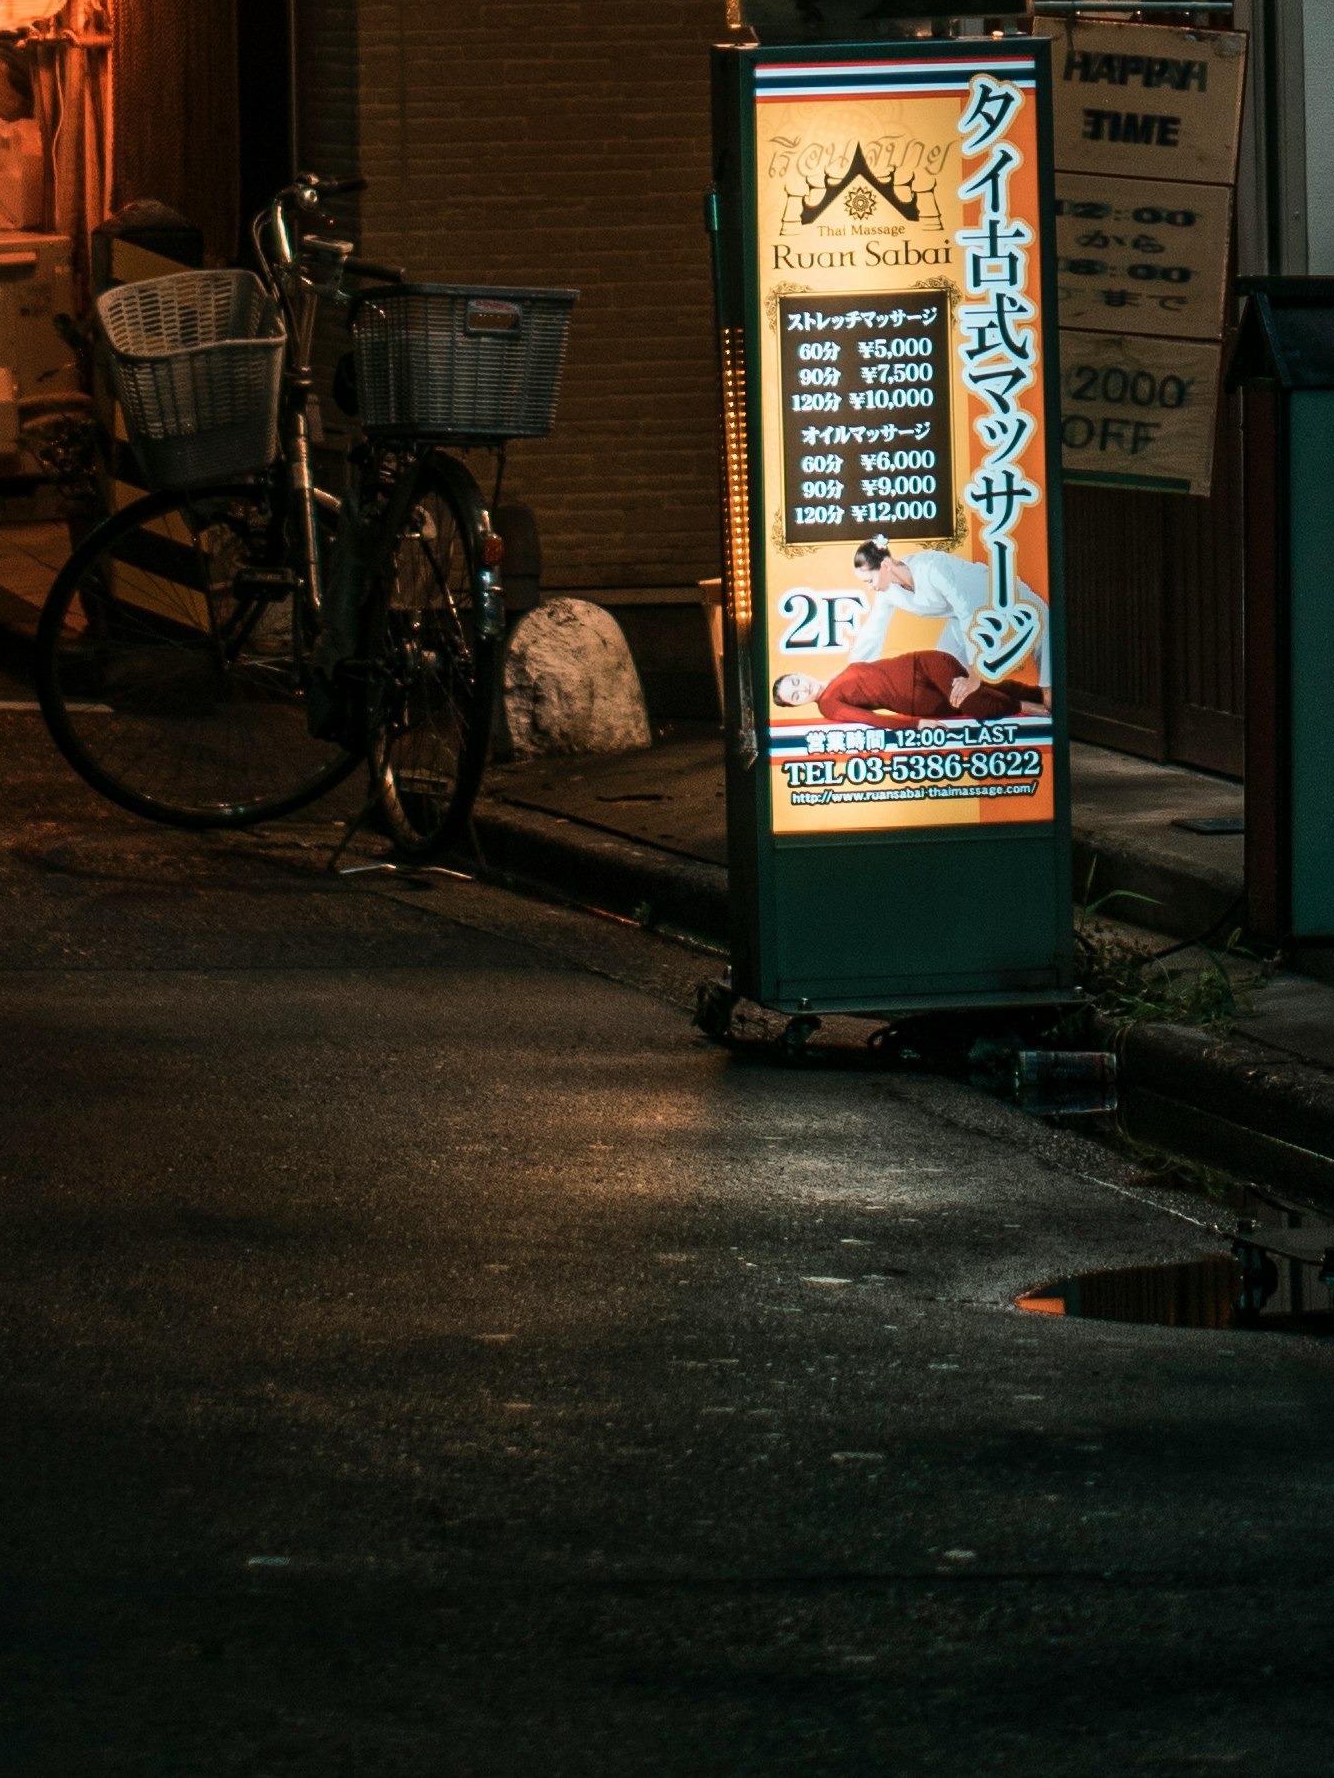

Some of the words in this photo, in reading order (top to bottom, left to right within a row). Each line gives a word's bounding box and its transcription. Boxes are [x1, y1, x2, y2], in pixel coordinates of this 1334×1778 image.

[1083, 108, 1182, 147] TIME
[817, 225, 846, 237] Thai
[851, 224, 906, 238] Massage
[1076, 230, 1166, 254] から
[772, 243, 857, 270] Ruan
[865, 239, 954, 267] Sabai
[787, 306, 938, 332] ストレッチマッサージ
[799, 341, 841, 361] 60分
[858, 337, 933, 360] ¥5,000
[799, 366, 842, 387] 90分
[860, 362, 934, 385] ¥7,500
[962, 81, 1037, 675] タイ古式マッサージ
[791, 391, 843, 412] 120分
[848, 387, 934, 410] ¥10,000
[801, 421, 931, 446] オイルマッサージ
[1061, 414, 1162, 454] OFF
[801, 454, 844, 474] 60分
[860, 449, 935, 472] ¥6,000
[802, 479, 845, 499] 90分
[861, 475, 937, 498] ¥9,000
[794, 504, 846, 525] 120分
[851, 500, 937, 523] ¥12,000
[783, 593, 865, 650] 2F
[806, 728, 886, 755] 営業時間
[784, 760, 843, 786] TEL
[846, 750, 1042, 785] 03-5386-8622
[791, 781, 1038, 805] http://www.ruansabai-thaimassage.com/
